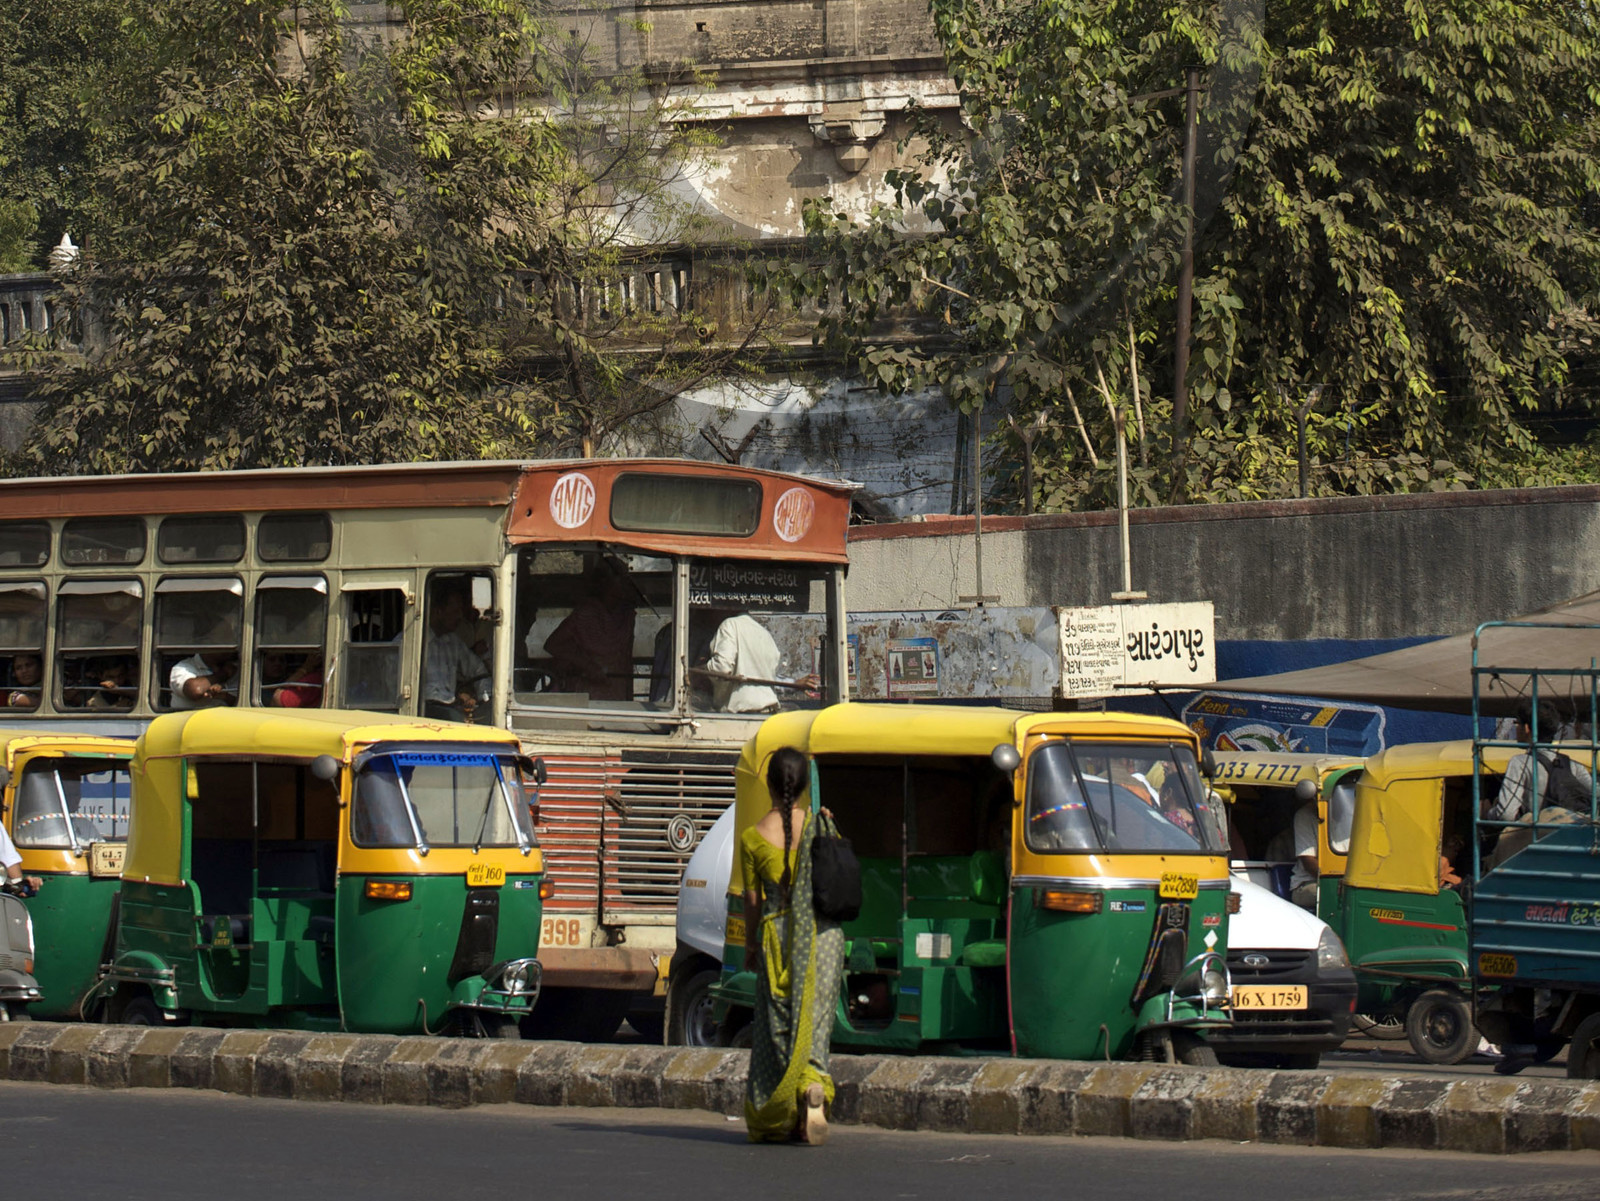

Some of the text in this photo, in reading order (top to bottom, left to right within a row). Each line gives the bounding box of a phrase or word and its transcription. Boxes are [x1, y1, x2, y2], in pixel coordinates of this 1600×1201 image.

[553, 476, 594, 524] AMTS
[1126, 622, 1205, 672] સારંગપુર
[1195, 698, 1229, 715] Fena
[1202, 761, 1302, 782] 033 7777
[542, 918, 580, 946] 398
[1254, 992, 1265, 1006] X
[1272, 992, 1302, 1007] 1759
